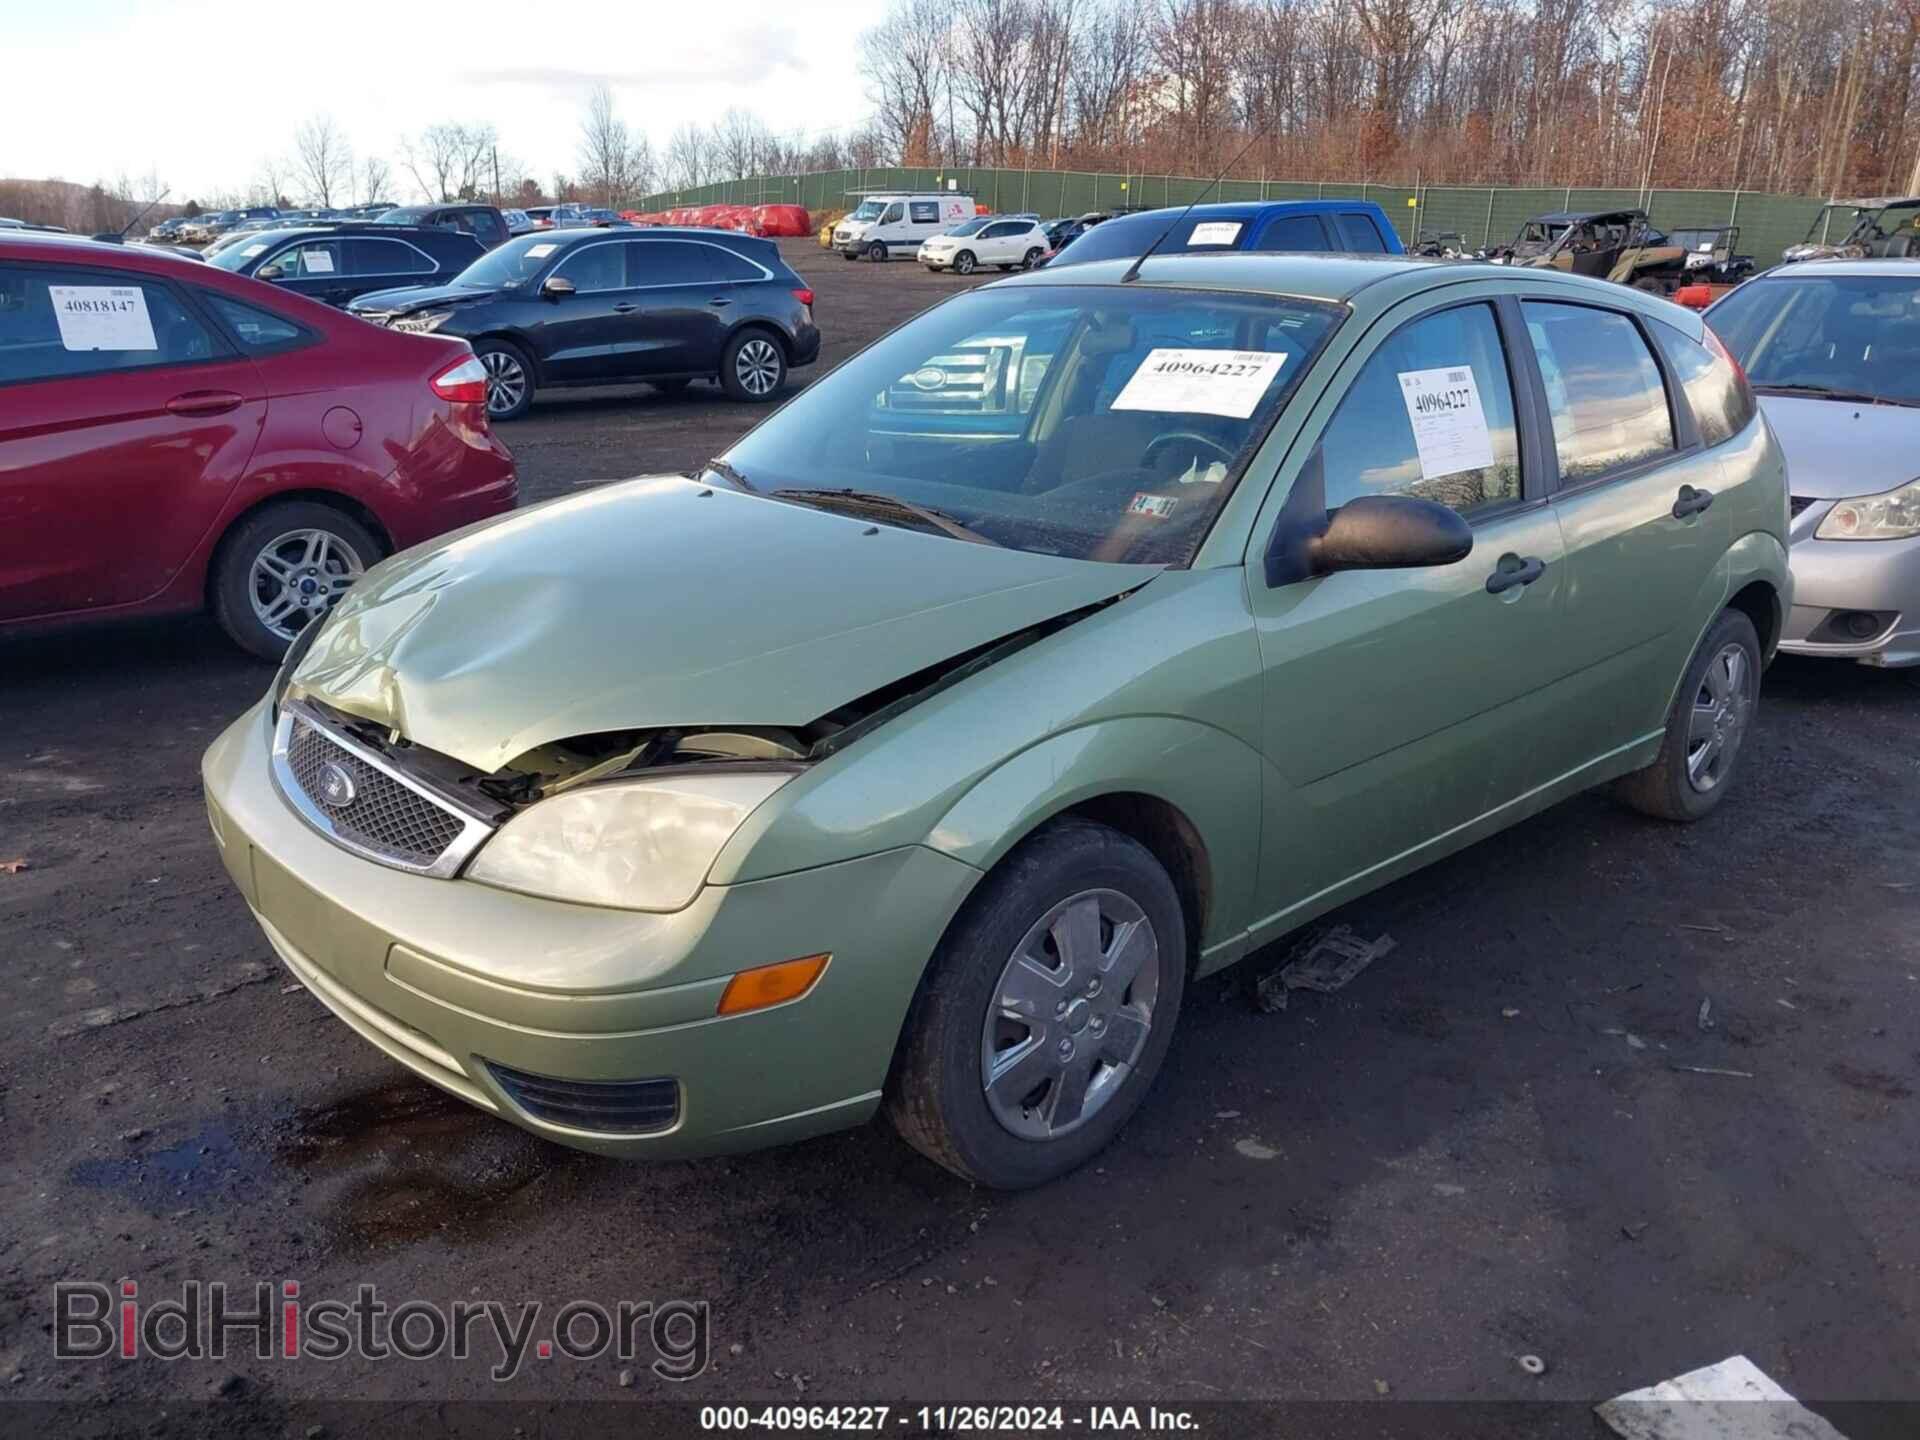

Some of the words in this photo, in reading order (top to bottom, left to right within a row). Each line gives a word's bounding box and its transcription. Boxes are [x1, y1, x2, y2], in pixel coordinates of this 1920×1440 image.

[64, 300, 135, 313] 40818147
[1153, 361, 1262, 377] 40964227
[1416, 389, 1472, 413] 40964227
